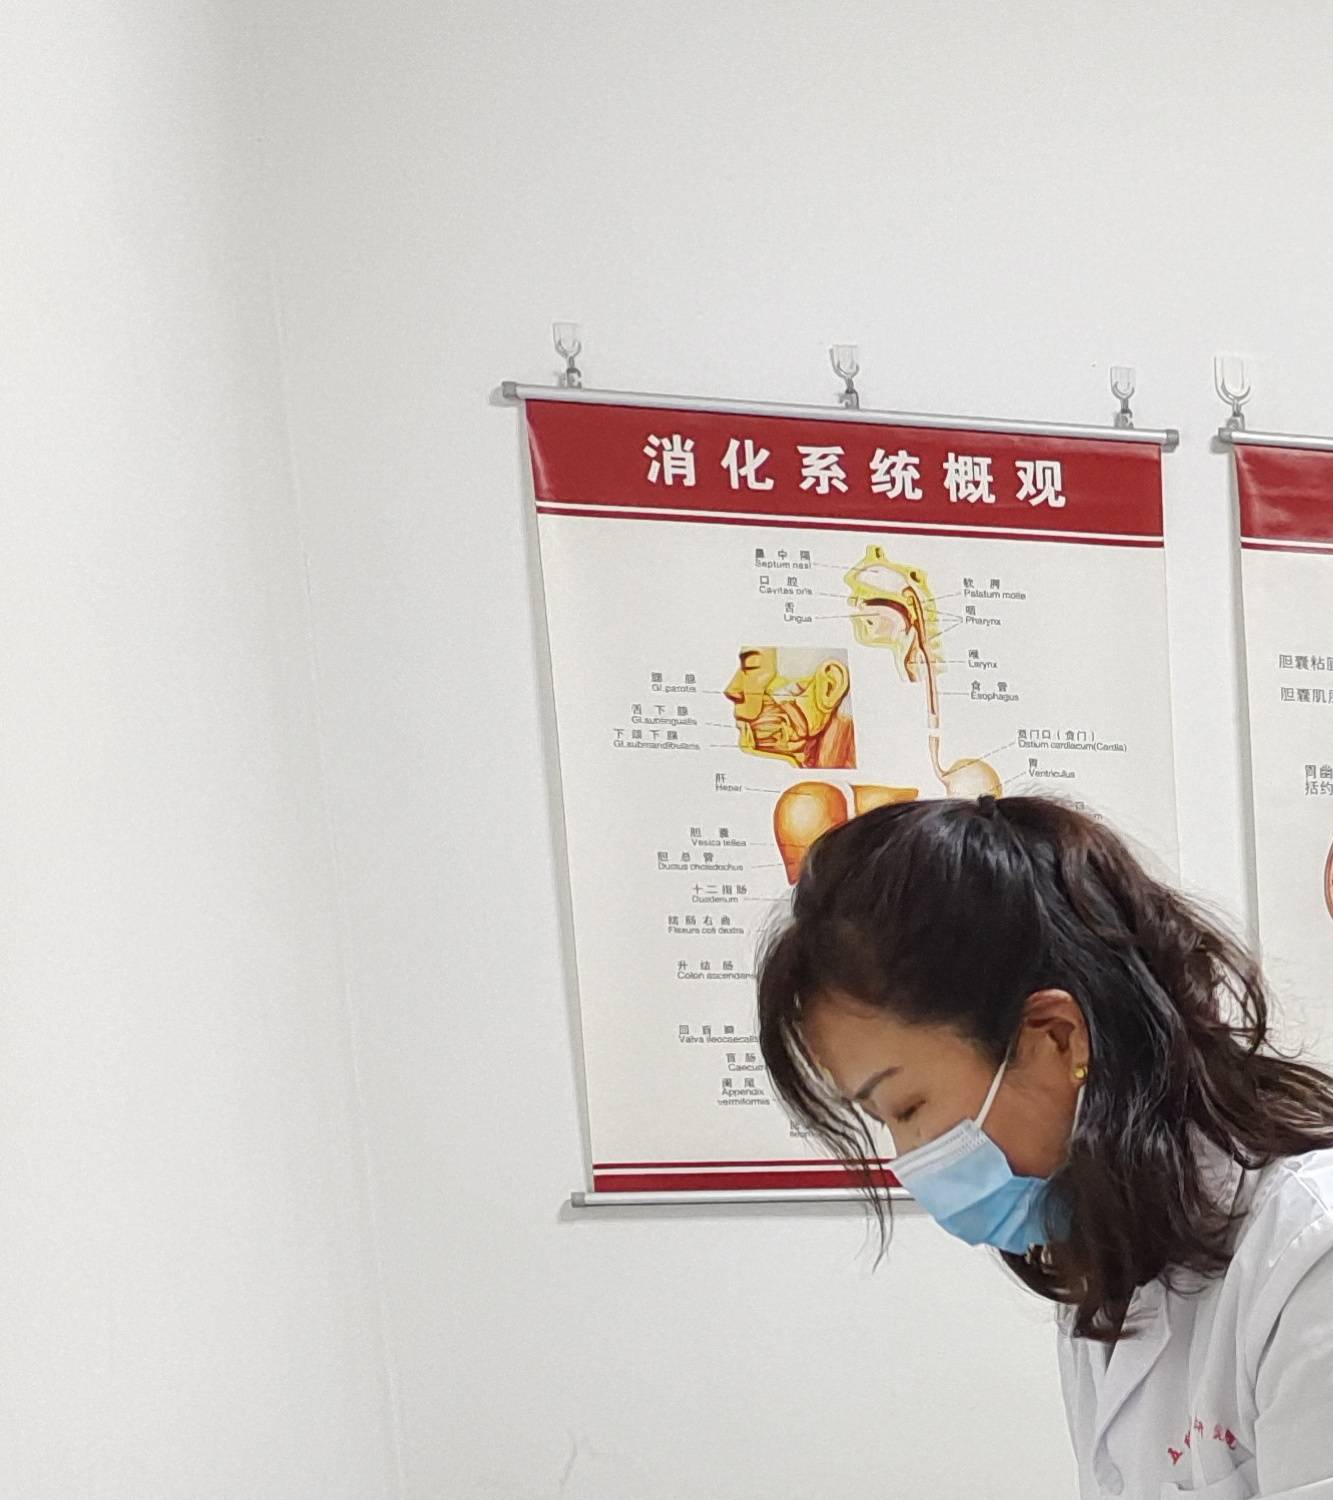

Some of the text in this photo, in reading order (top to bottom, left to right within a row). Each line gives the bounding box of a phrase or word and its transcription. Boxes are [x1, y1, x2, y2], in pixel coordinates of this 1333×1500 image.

[643, 434, 1067, 509] 消化系统概观
[755, 560, 790, 569] Septum
[784, 614, 812, 624] Lingua
[966, 616, 1001, 626] Pharynx
[969, 660, 997, 669] Larynx
[971, 692, 1019, 702] Esophagus
[1018, 740, 1048, 748] Ostium
